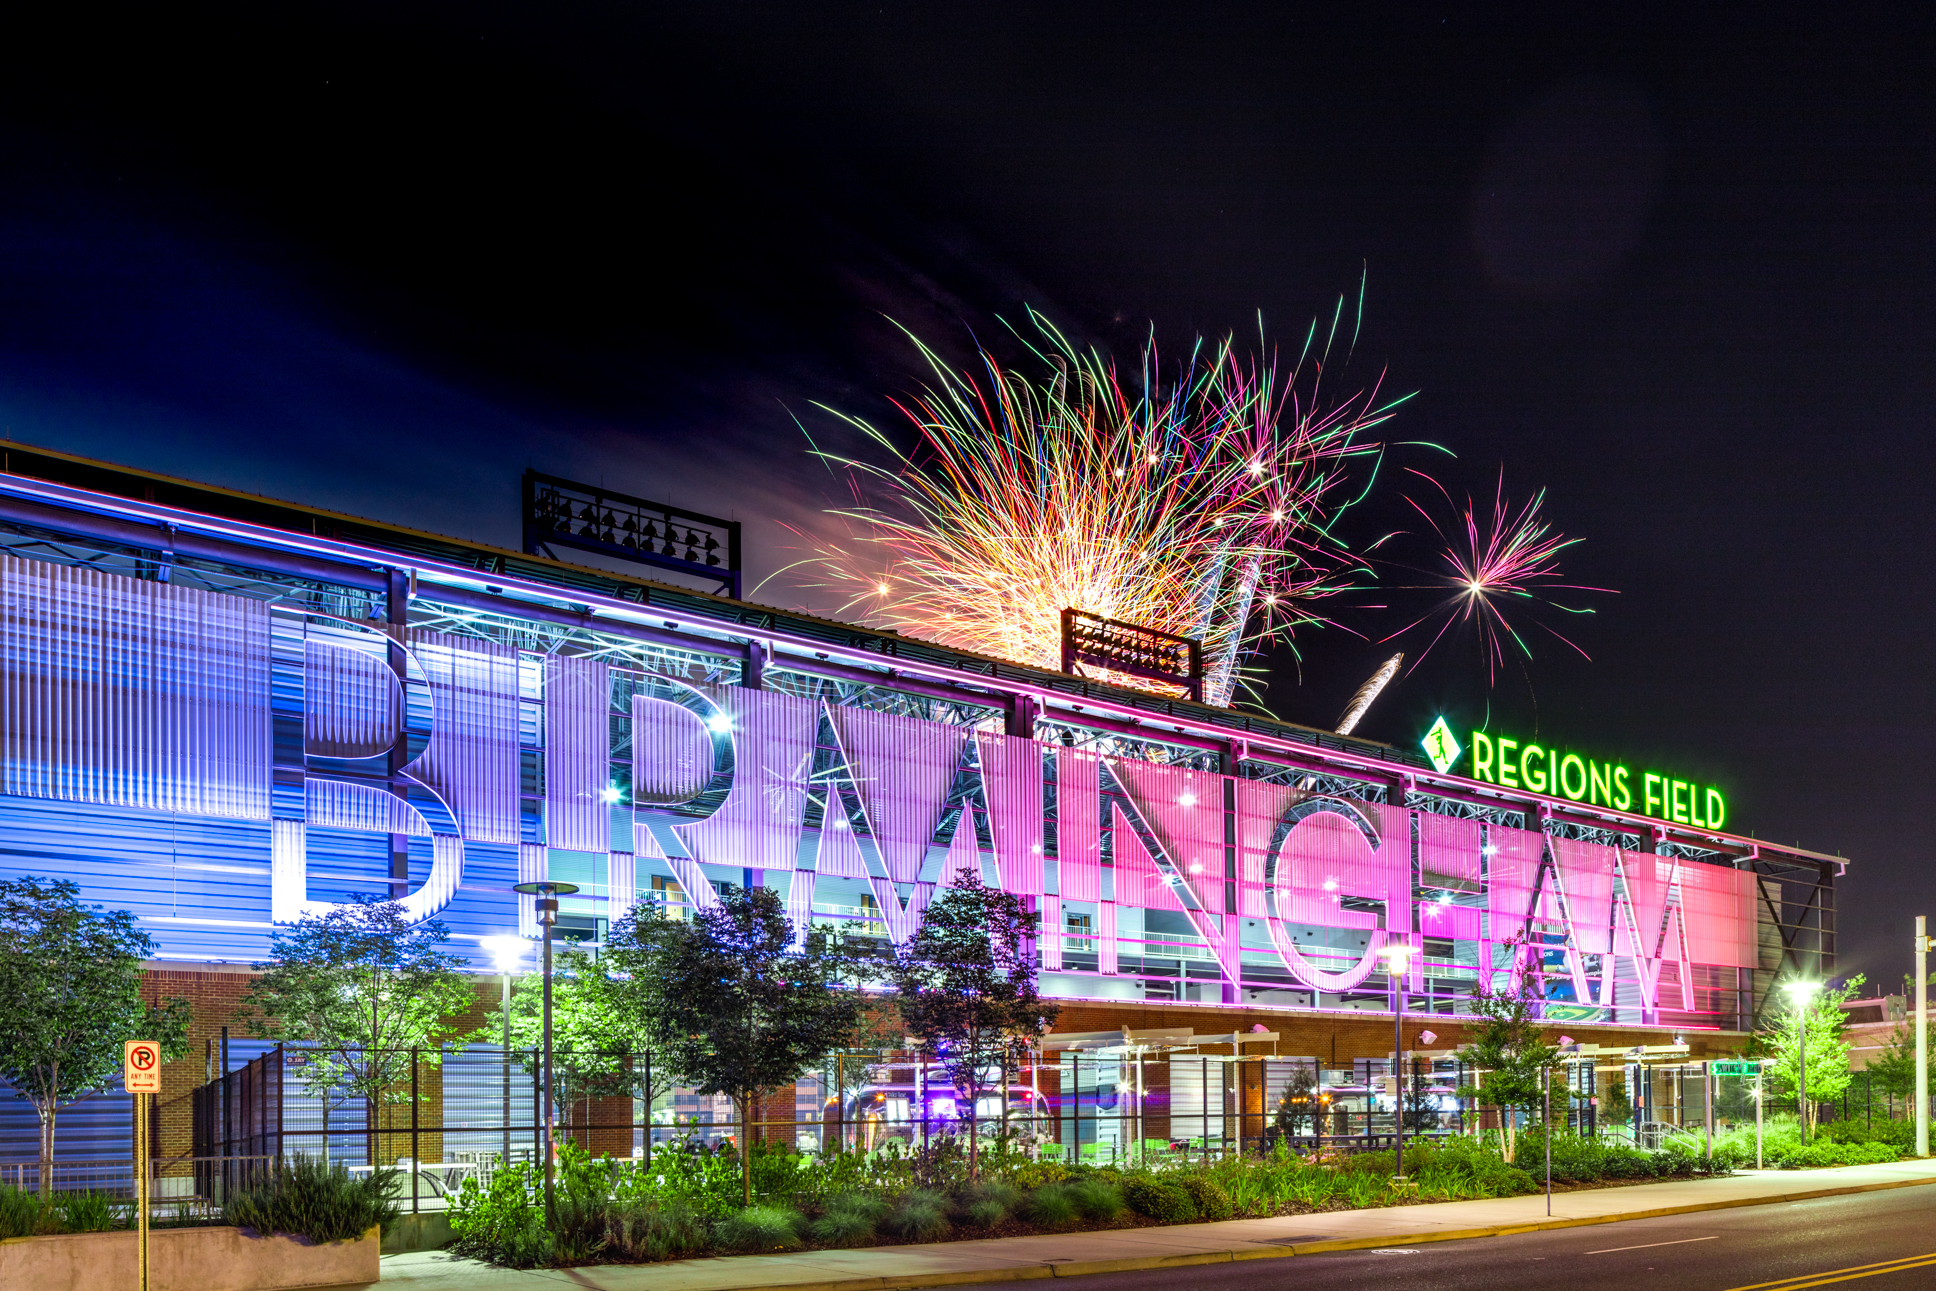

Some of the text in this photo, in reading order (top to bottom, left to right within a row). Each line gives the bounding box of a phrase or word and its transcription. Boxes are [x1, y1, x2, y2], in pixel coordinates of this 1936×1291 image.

[271, 604, 1696, 1014] BIRMINGHAM
[1472, 730, 1725, 830] REGIONS FIELD
